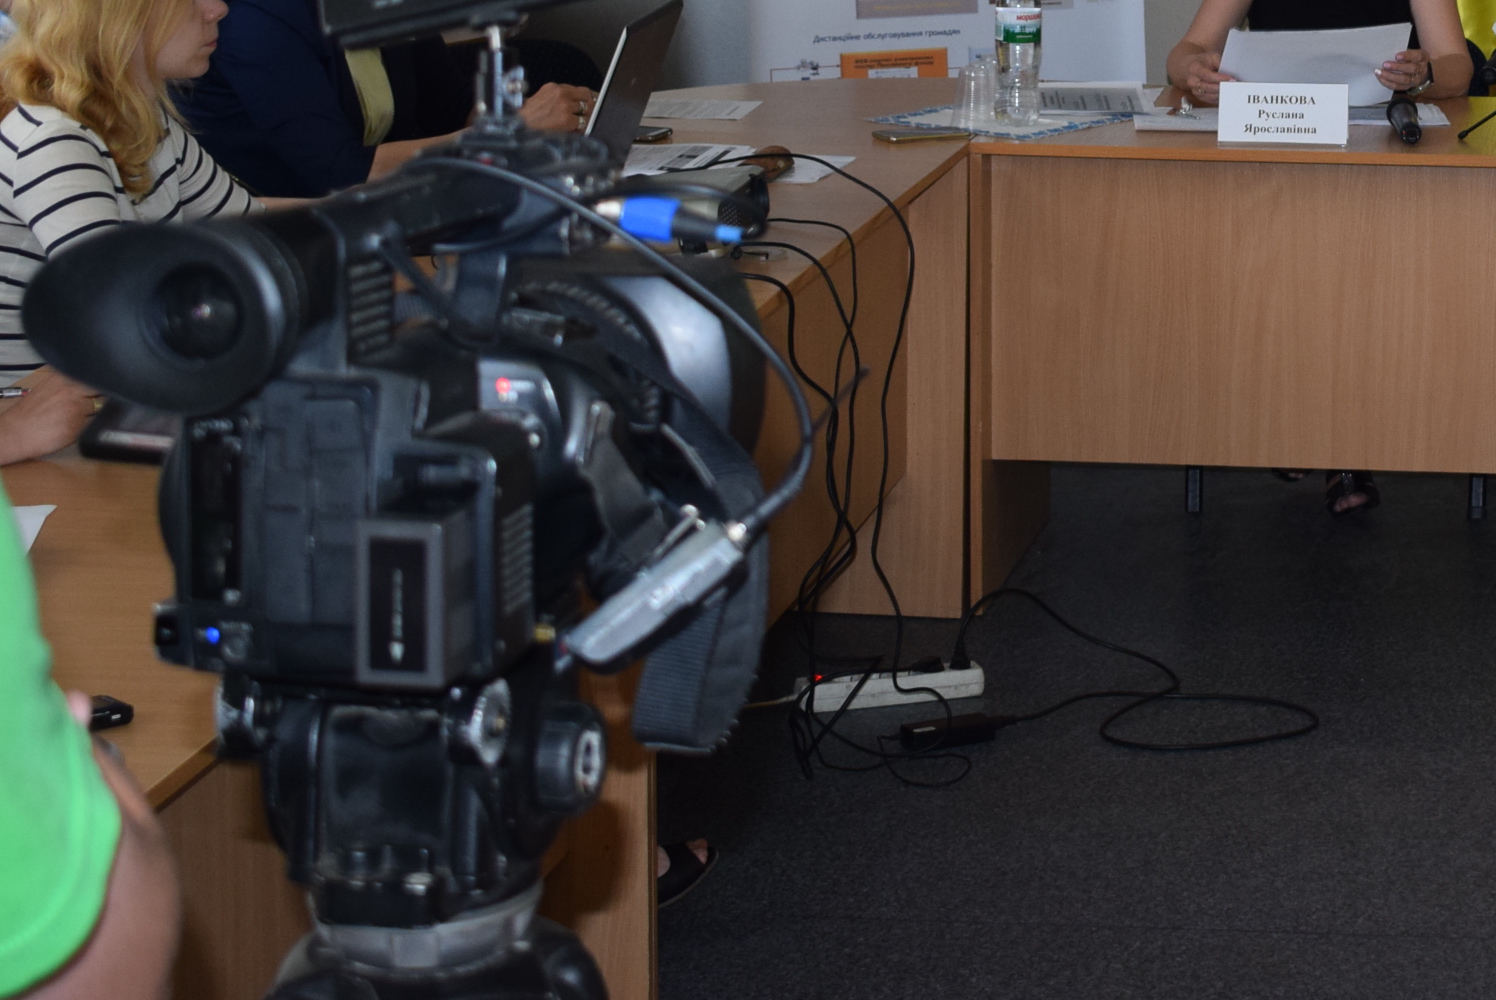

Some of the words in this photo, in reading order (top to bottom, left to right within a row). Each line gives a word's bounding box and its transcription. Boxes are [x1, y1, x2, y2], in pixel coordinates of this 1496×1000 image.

[813, 33, 861, 44] Дистанційне
[863, 30, 923, 42] обслуговування
[925, 28, 960, 38] громадян
[1247, 94, 1316, 105] ІВАНКОВА
[1258, 109, 1304, 121] Руслана
[1244, 123, 1317, 135] Ярославівна
